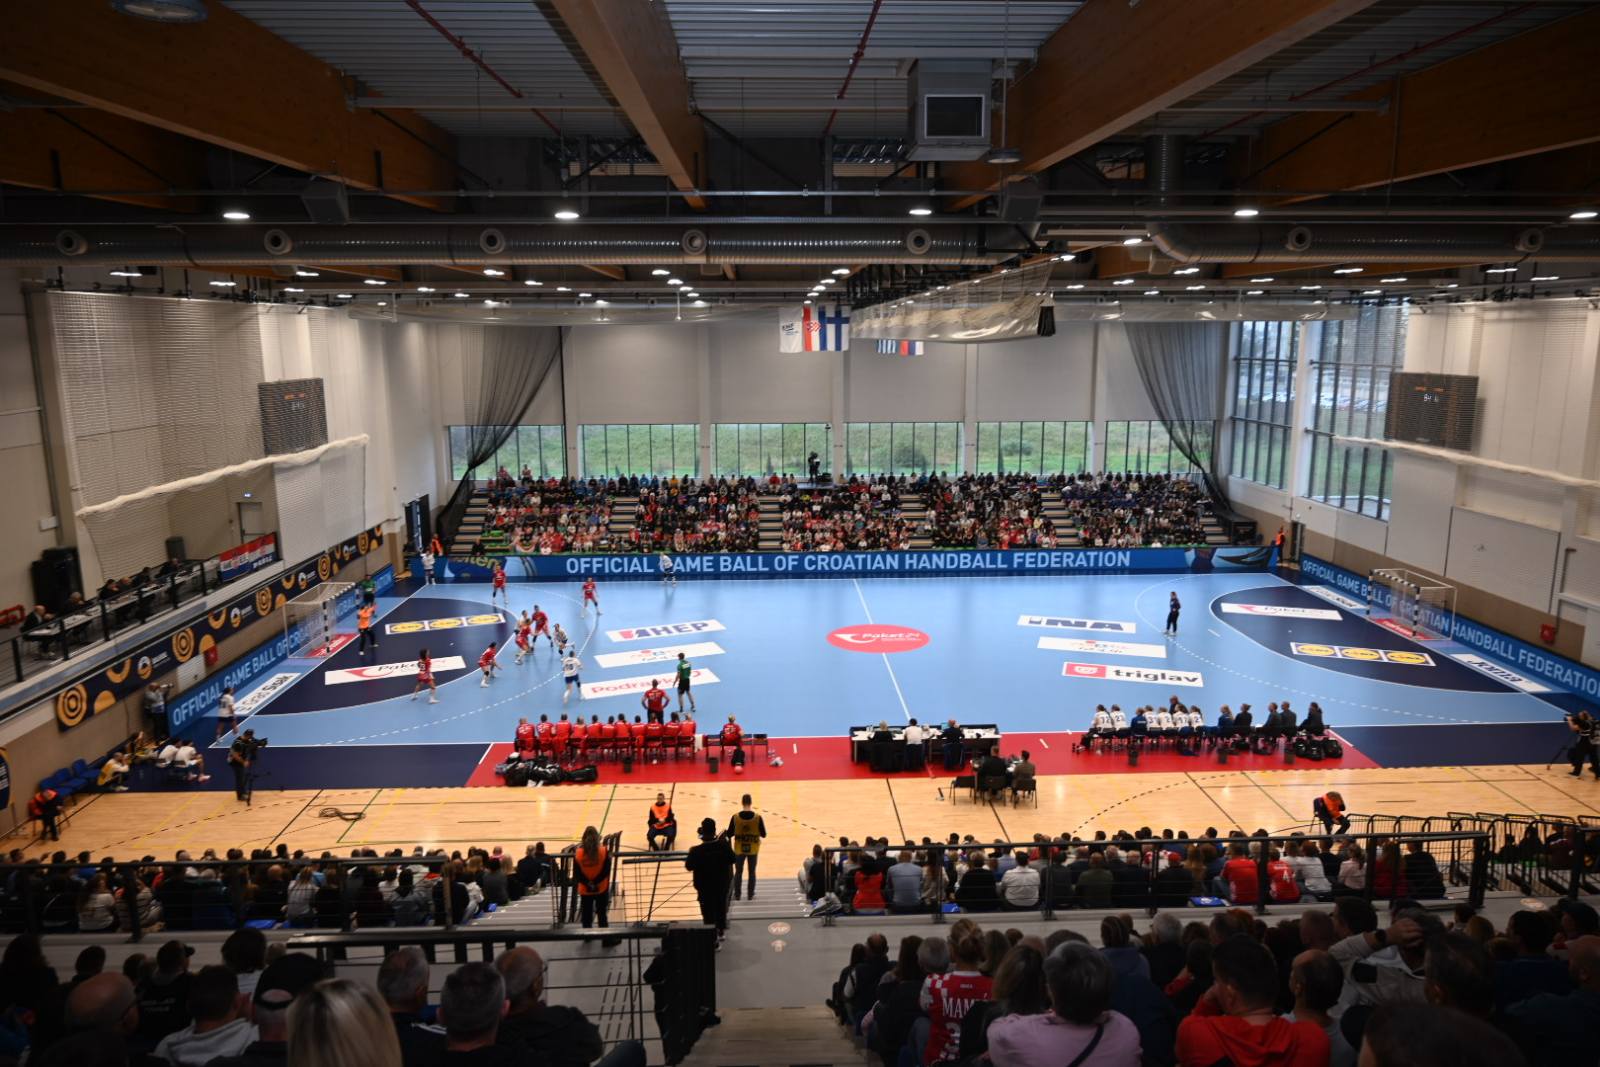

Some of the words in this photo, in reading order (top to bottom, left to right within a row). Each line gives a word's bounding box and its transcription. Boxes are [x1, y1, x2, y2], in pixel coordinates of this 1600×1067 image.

[566, 556, 654, 574] OFFICIAL
[719, 555, 769, 573] BALL
[774, 555, 799, 571] OF
[804, 554, 899, 571] CROATIAN
[905, 553, 1008, 569] HANDBALL
[1013, 551, 1130, 568] FEDERATION
[652, 622, 709, 636] HEP
[1302, 560, 1336, 584] OFFICIAL
[1337, 574, 1360, 593] GAME
[1361, 583, 1384, 605] BLL
[1400, 600, 1450, 632] CRATIAN
[1451, 618, 1515, 661] HANDBALL
[1518, 649, 1600, 698] FEDERATIO
[173, 683, 223, 726] OFFICIAL
[223, 662, 252, 690] GAME
[251, 648, 276, 672] BALL
[1113, 669, 1199, 683] triglav
